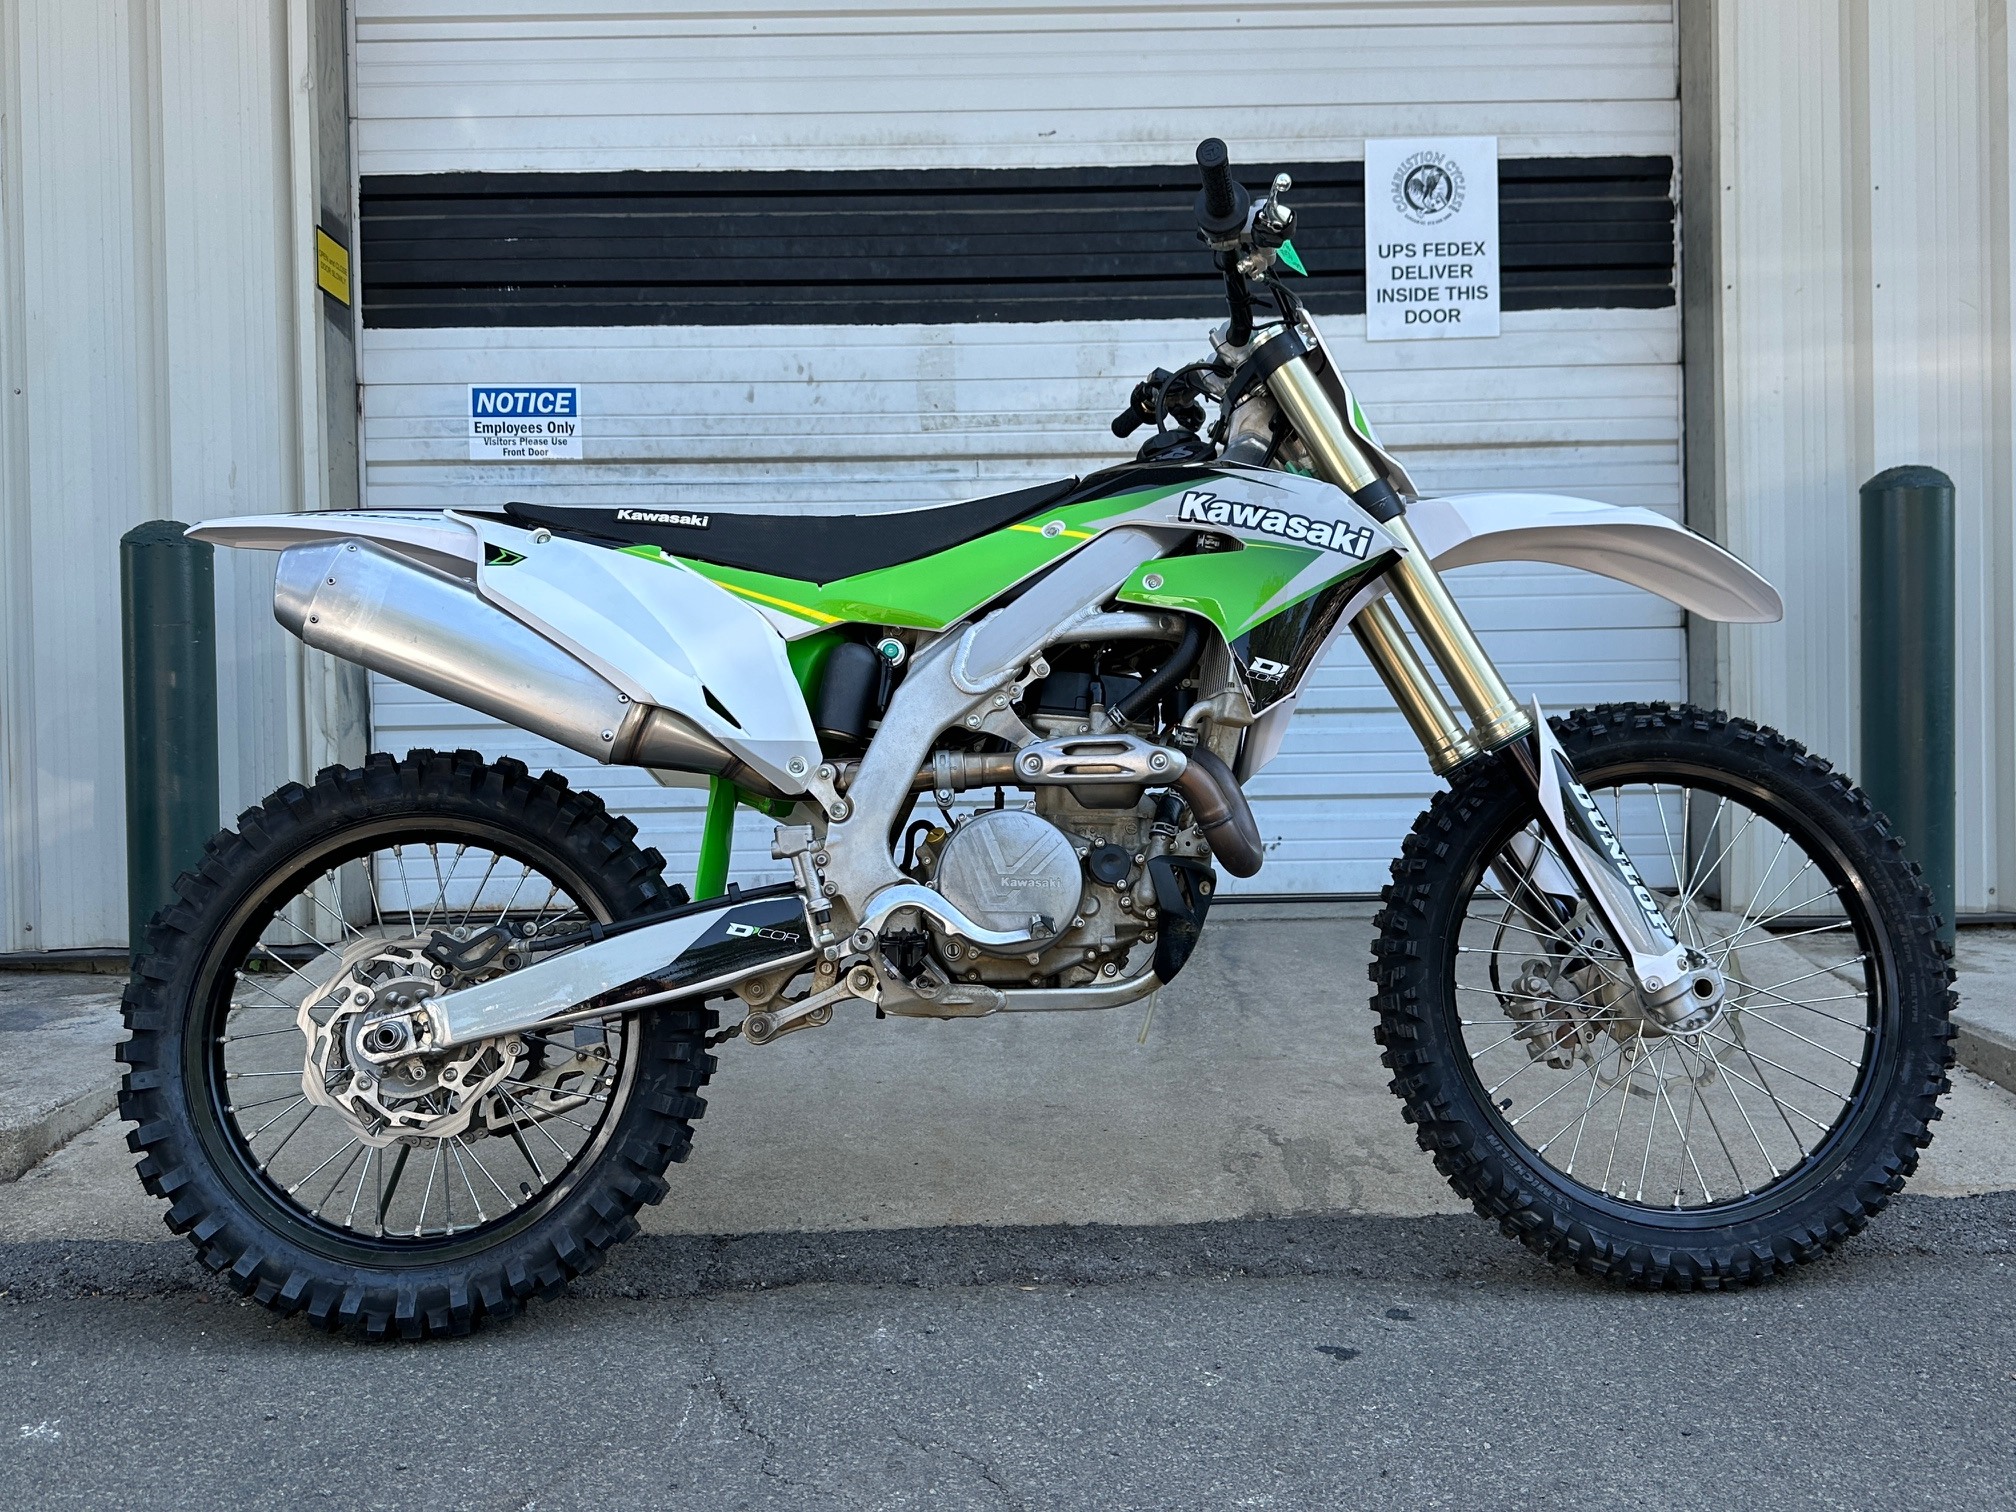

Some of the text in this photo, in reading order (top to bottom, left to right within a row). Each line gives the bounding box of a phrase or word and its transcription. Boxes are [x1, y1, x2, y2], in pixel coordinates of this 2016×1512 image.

[1391, 151, 1446, 212] COMBUSTION
[1378, 241, 1486, 259] UPS FEDEX
[1391, 264, 1473, 281] DELIVER
[1376, 285, 1489, 303] INSIDE THIS
[1405, 308, 1461, 324] DOOR
[477, 392, 572, 413] NOTICE
[474, 421, 575, 436] Employees Only
[483, 437, 568, 446] Visitors Please Use
[502, 448, 549, 457] Front Door
[617, 509, 710, 527] Kawasaki
[1178, 491, 1374, 560] Kawasaki
[1568, 780, 1676, 938] DUNLOP
[1001, 876, 1062, 888] Kawasaki
[1485, 1134, 1554, 1198] MICHELIN
